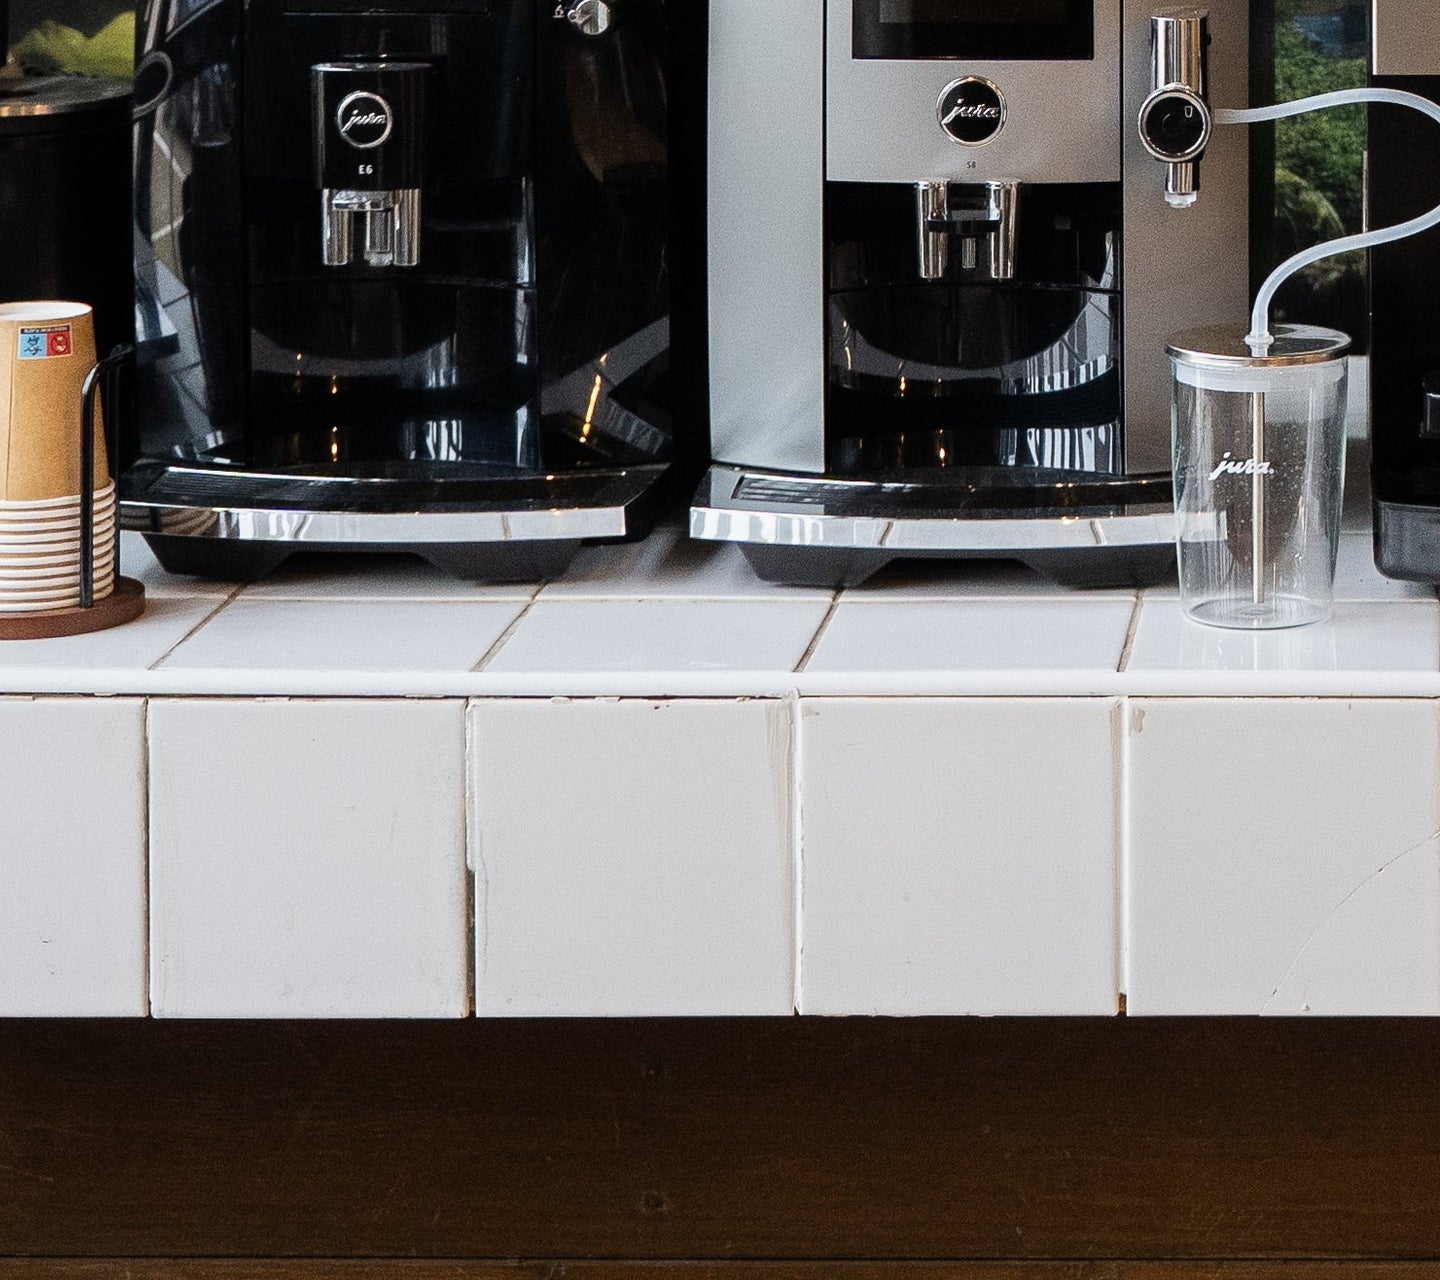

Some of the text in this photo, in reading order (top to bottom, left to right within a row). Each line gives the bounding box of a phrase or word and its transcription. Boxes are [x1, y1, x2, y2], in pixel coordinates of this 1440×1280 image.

[341, 109, 386, 132] jura
[940, 98, 1000, 124] jura
[358, 164, 374, 175] E6
